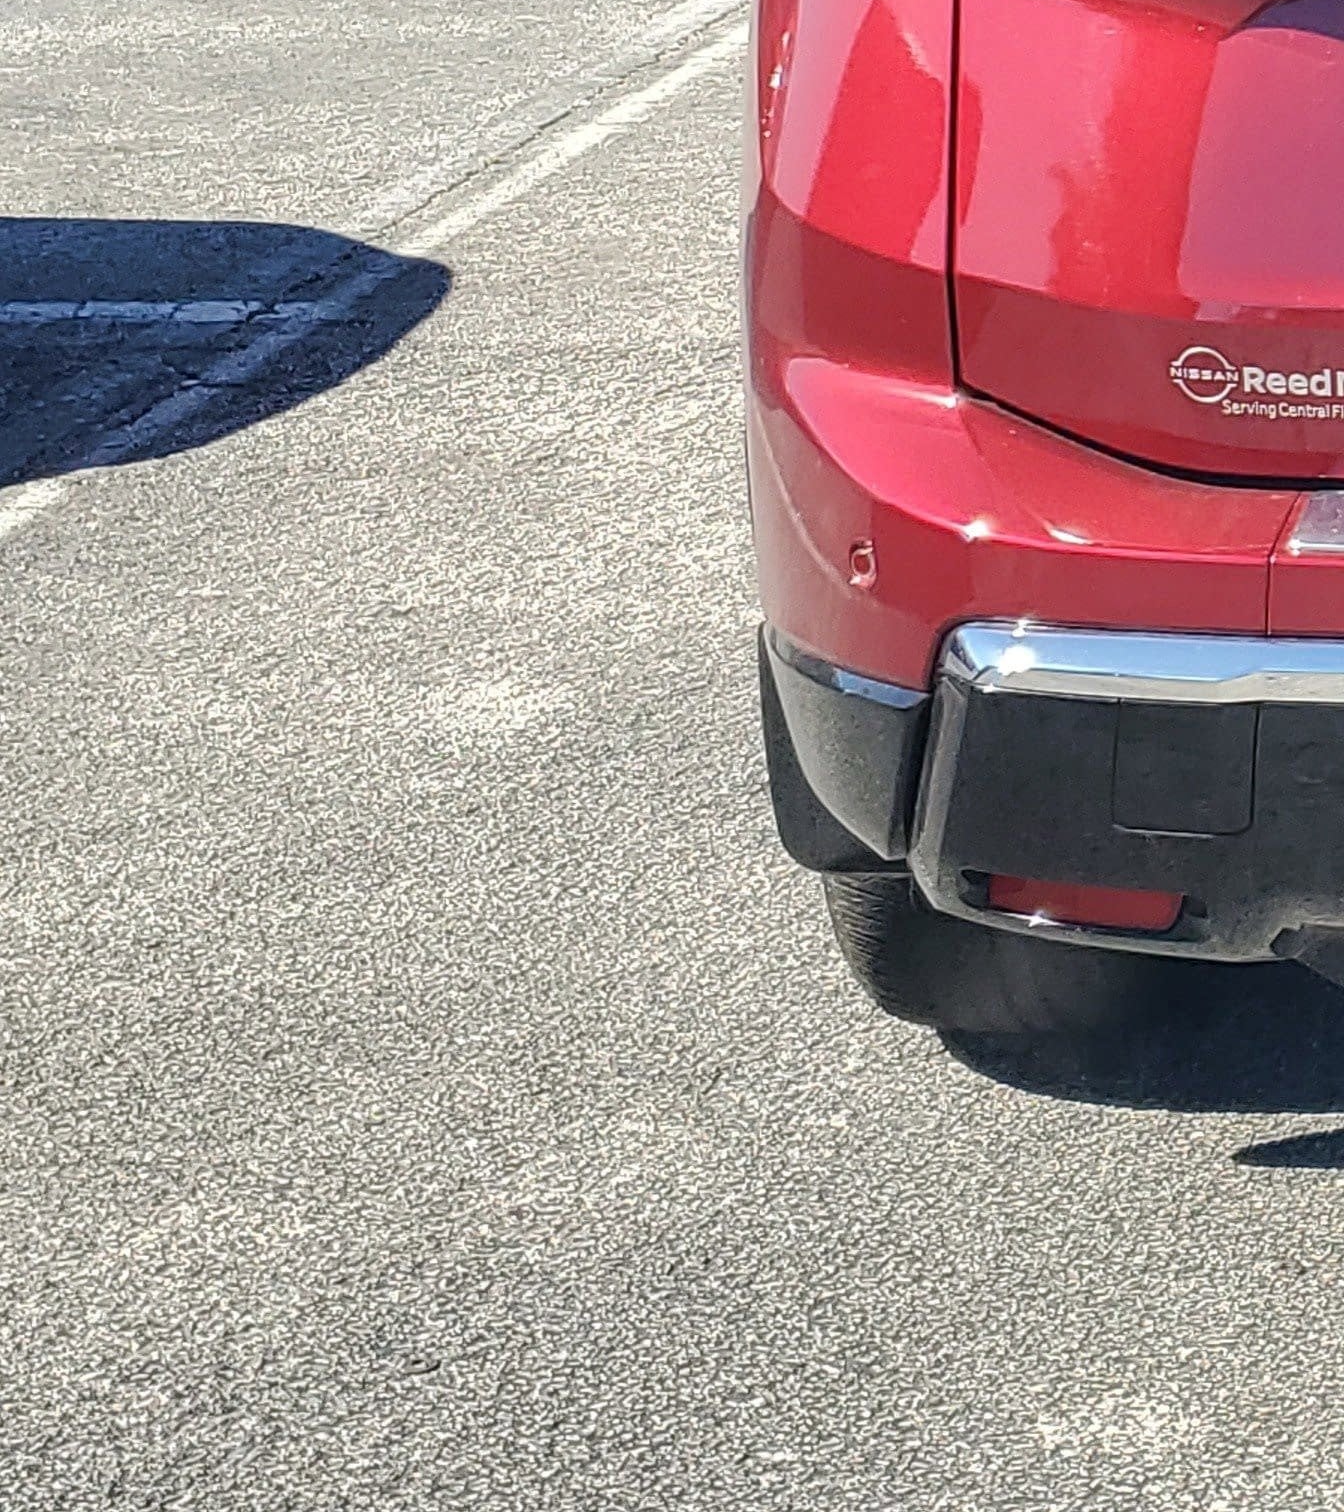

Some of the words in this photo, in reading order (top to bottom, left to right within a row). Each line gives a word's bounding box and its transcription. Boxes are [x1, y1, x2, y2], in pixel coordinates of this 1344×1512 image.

[1169, 367, 1239, 382] NISSAN
[1242, 366, 1332, 397] Reed
[1221, 399, 1277, 420] Serving
[1278, 401, 1330, 419] Central
